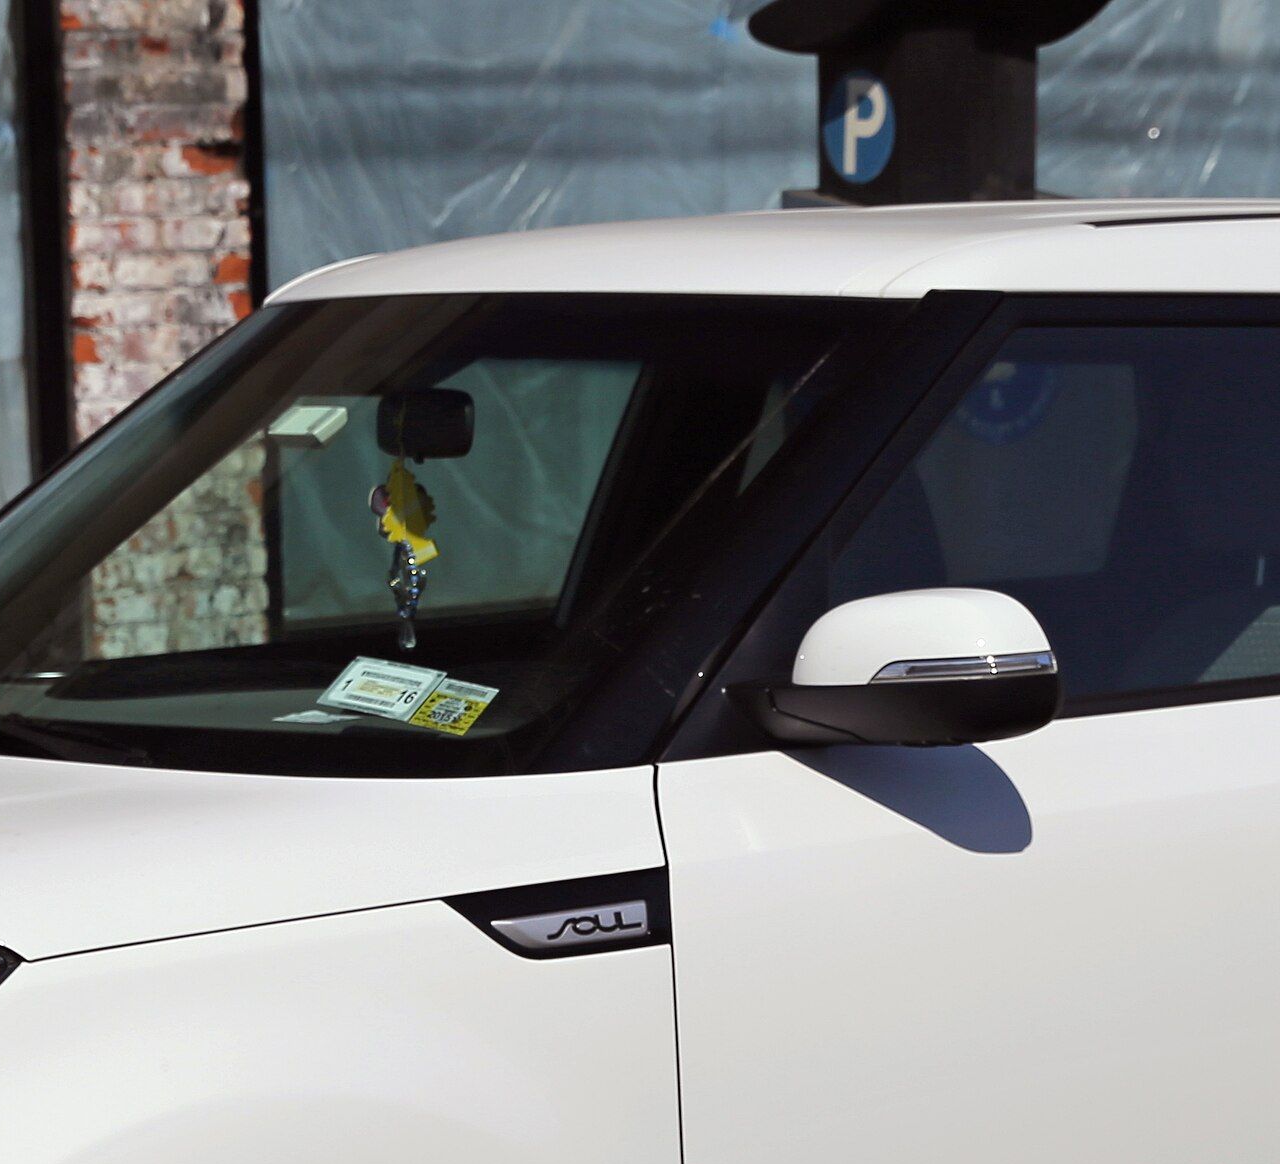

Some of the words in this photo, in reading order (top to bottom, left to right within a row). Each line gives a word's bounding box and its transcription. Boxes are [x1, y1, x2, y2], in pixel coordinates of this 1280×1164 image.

[842, 79, 888, 176] P
[396, 689, 419, 706] 16
[546, 911, 643, 941] SOUL
